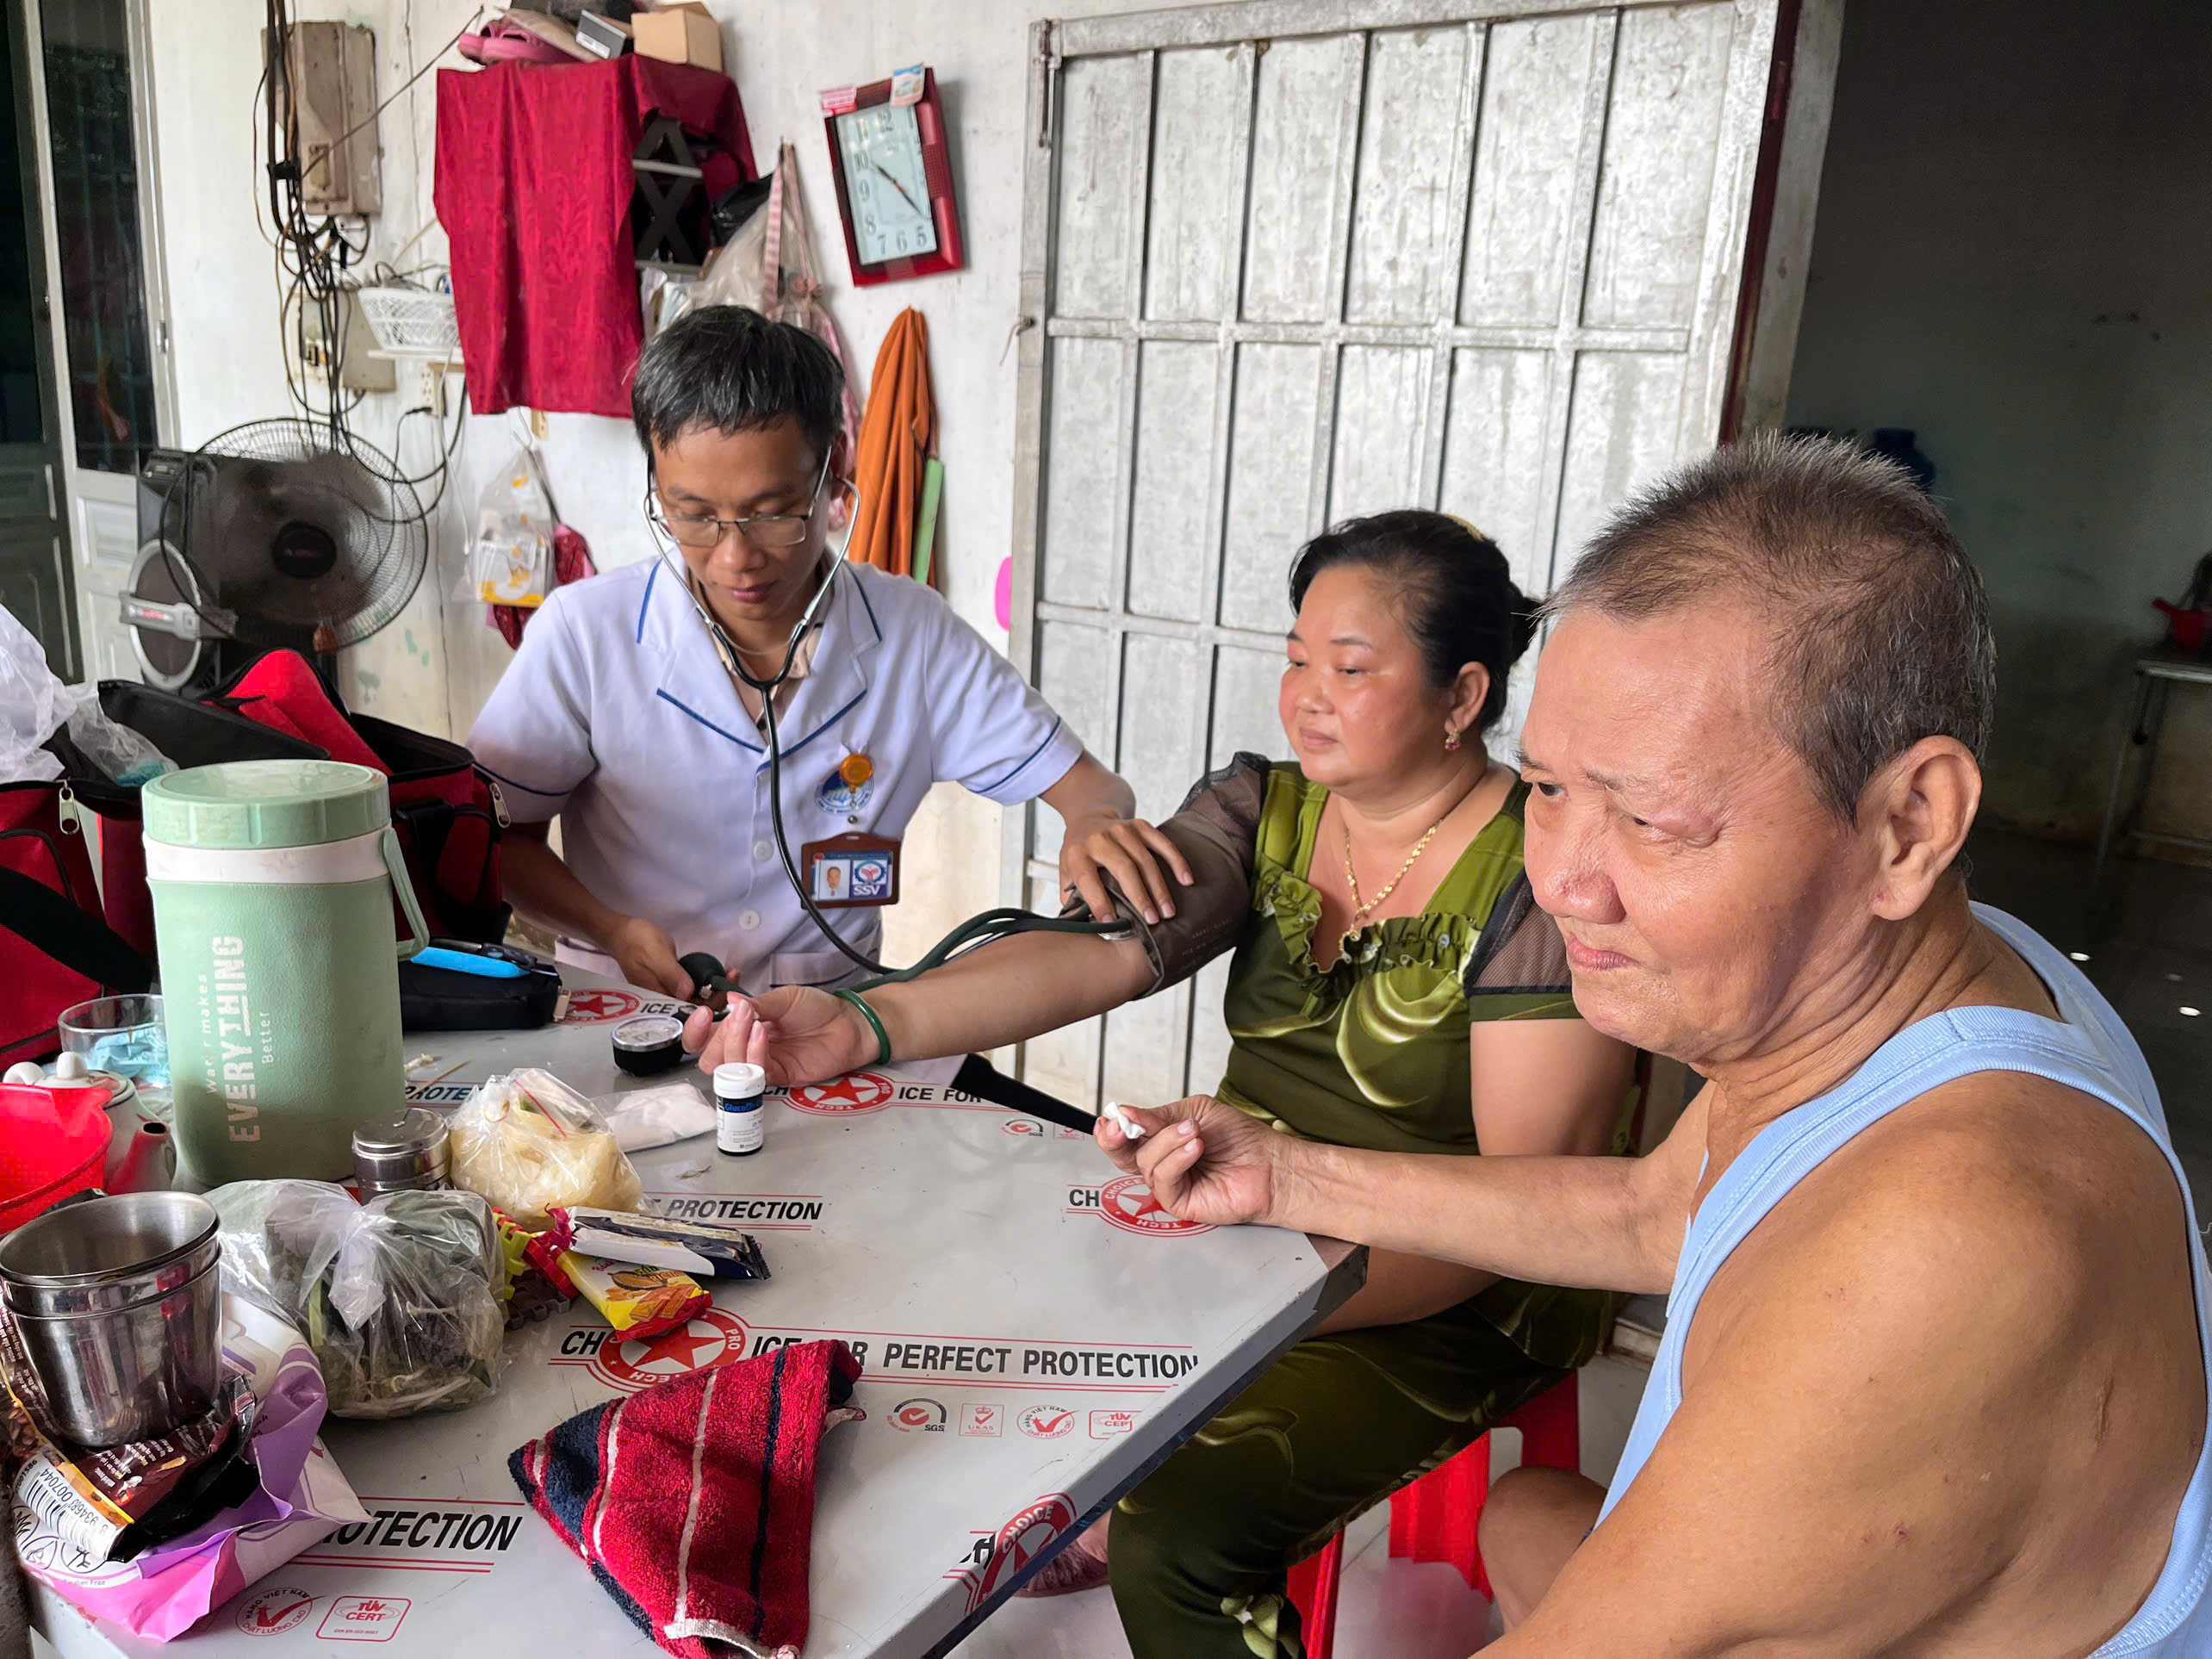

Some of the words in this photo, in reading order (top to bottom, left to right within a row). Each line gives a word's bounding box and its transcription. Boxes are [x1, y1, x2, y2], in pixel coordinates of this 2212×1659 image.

[877, 233, 887, 254] 7
[896, 230, 907, 252] 6
[916, 226, 927, 247] 5
[854, 884, 881, 896] SSV
[198, 973, 211, 1034] makes
[641, 1003, 675, 1015] ICE
[213, 936, 260, 1142] EVERYTHING
[261, 1012, 274, 1064] Better
[406, 1086, 482, 1100] PROTE
[898, 1086, 934, 1101] ICE
[1069, 1189, 1100, 1207] CH
[1104, 1178, 1143, 1200] CHOICE
[664, 1199, 823, 1220] PROTECTION
[1137, 1219, 1182, 1228] TECH
[725, 1328, 741, 1351] PRO
[561, 1331, 606, 1355] CH
[883, 1343, 1011, 1373] PERFECT
[1023, 1350, 1198, 1378] PROTECTION
[40, 1468, 73, 1502] 007044
[323, 1509, 523, 1550] OTECTION
[1002, 1505, 1055, 1553] CHOICE
[345, 1612, 386, 1621] CERT
[357, 1600, 386, 1612] TÜV
